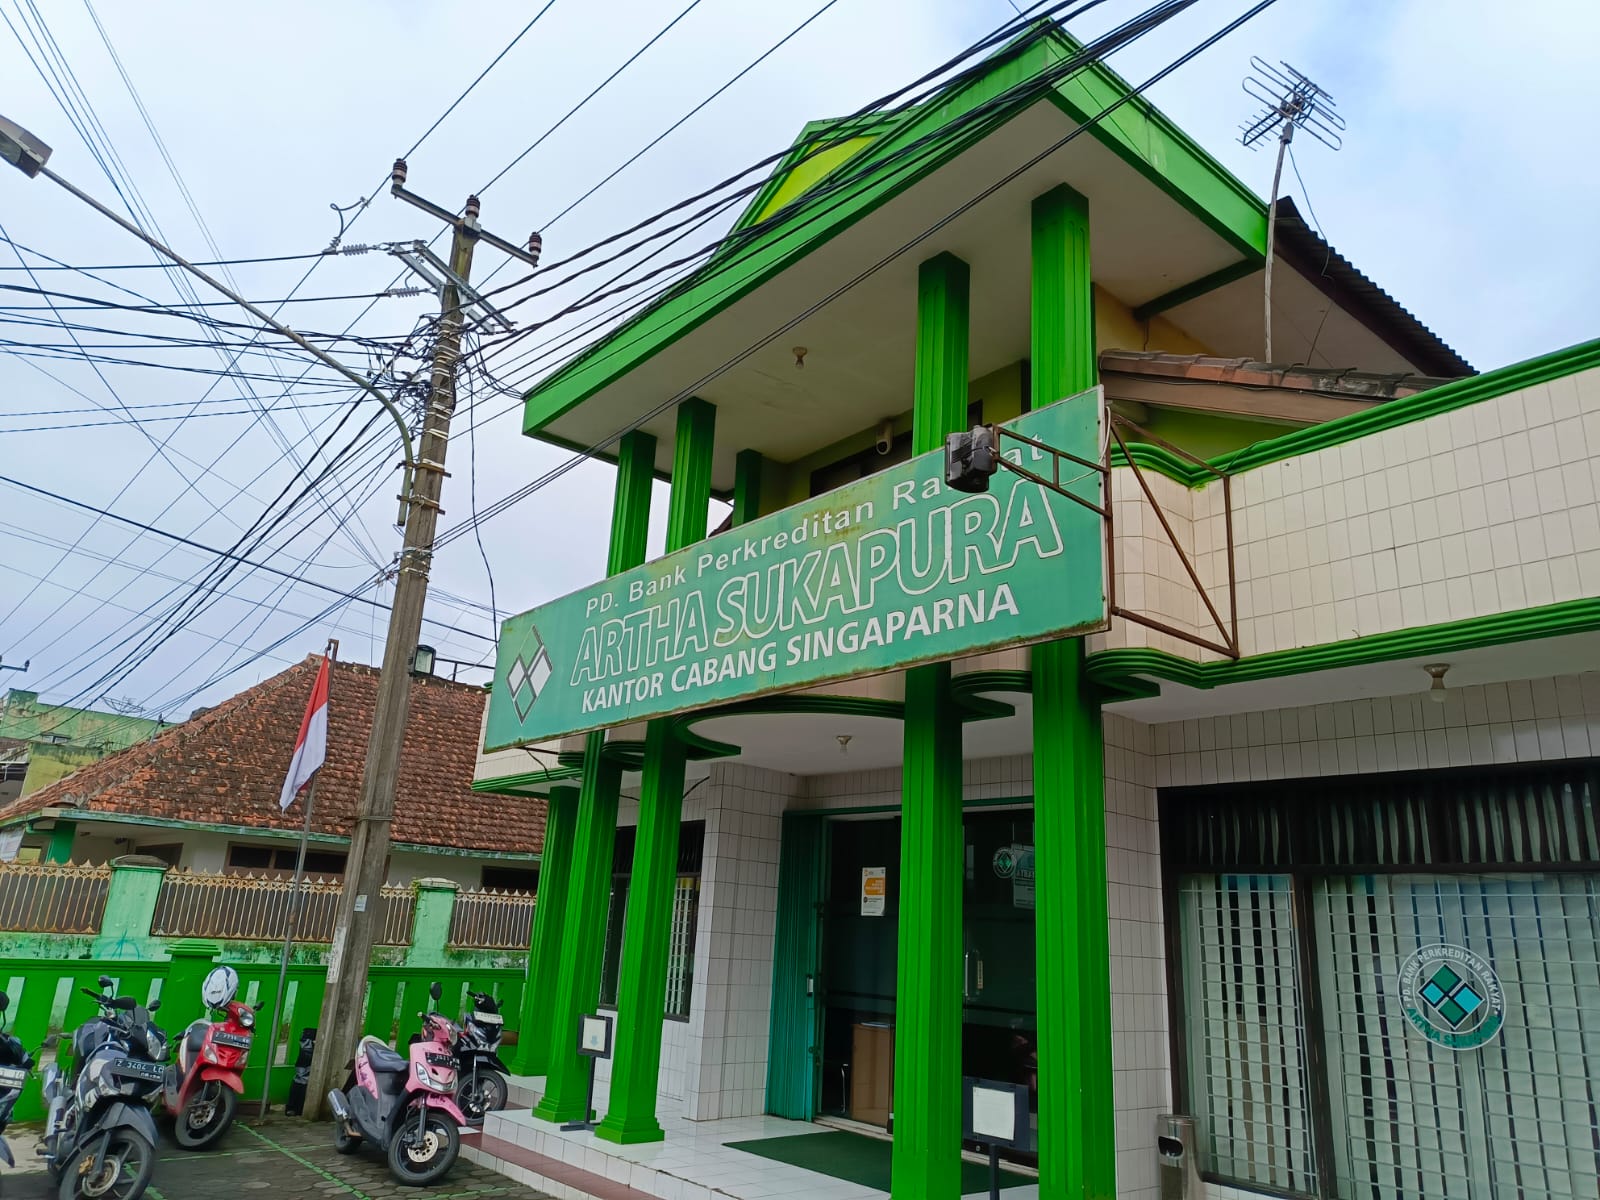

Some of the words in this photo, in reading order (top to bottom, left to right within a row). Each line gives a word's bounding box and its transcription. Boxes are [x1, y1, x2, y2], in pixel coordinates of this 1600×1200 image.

[570, 590, 709, 686] ARTHA
[713, 477, 1064, 647] SUKAPURA
[585, 592, 619, 618] PD.
[629, 566, 687, 602] Bank
[697, 501, 875, 578] Perkreditan
[892, 434, 1044, 510] Raat
[581, 672, 664, 714] KANTOR
[671, 641, 777, 692] CABANG
[786, 583, 1019, 666] SINGAPARNA
[1403, 960, 1419, 985] BANK
[1417, 948, 1484, 972] PERKREDITAN
[1481, 970, 1502, 1010] RAKYAT
